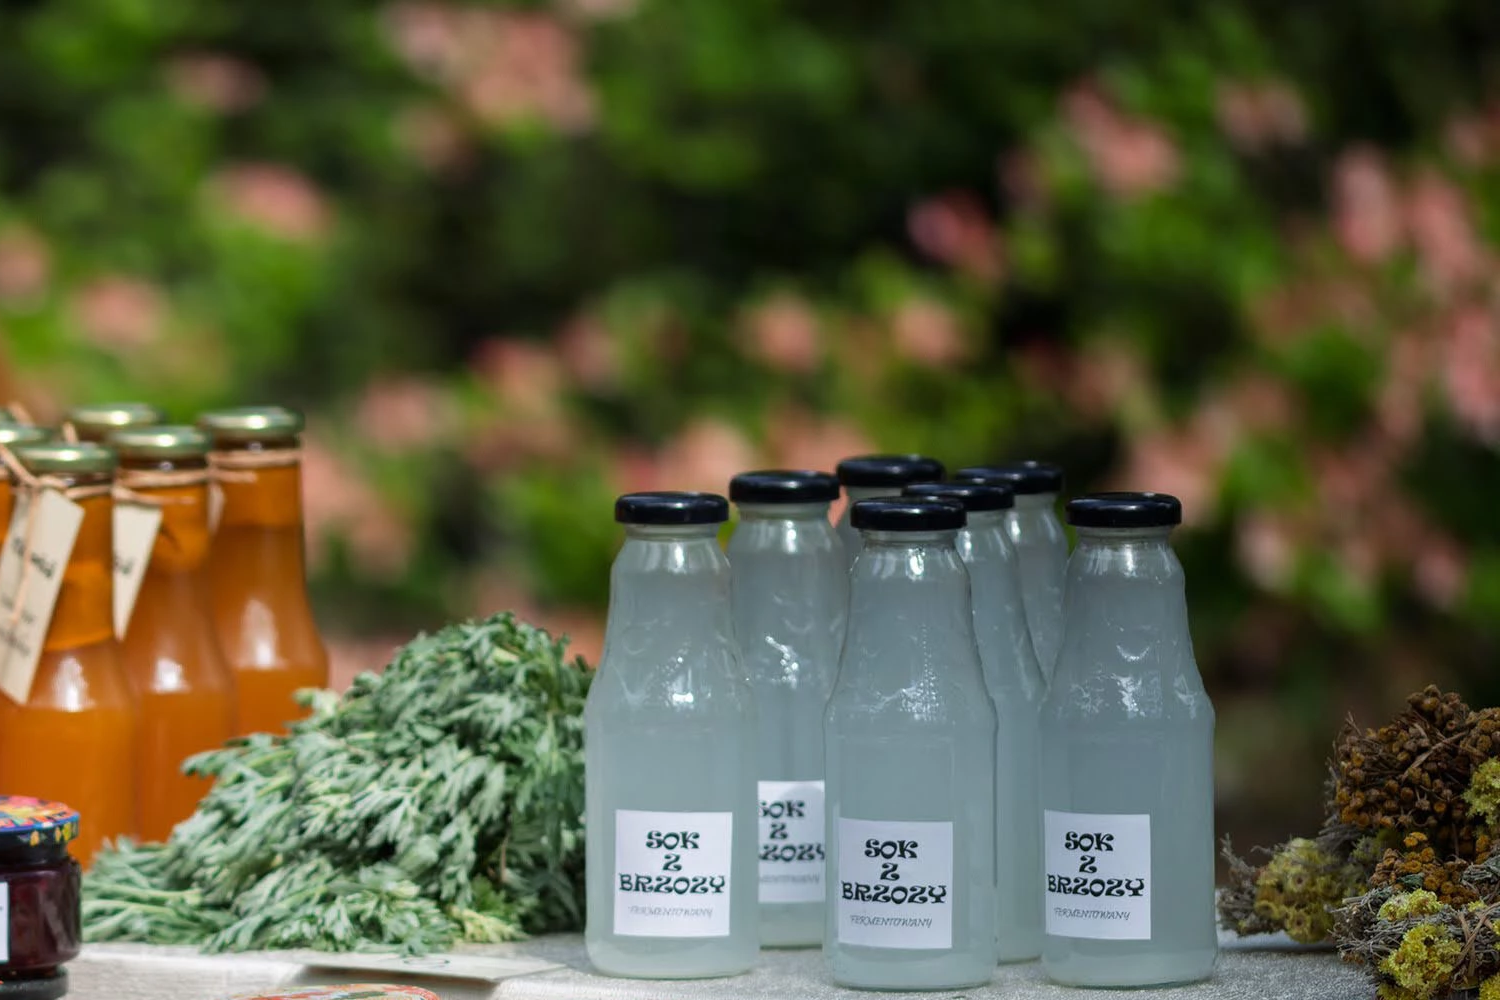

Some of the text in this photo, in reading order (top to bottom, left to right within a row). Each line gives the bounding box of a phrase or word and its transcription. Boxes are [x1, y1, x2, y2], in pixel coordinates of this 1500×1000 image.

[645, 830, 699, 850] SOK
[769, 821, 788, 839] Z
[864, 838, 918, 860] SOK
[1064, 830, 1114, 852] SOK
[662, 853, 682, 871] Z
[880, 862, 900, 881] Z
[1078, 854, 1097, 873] Z
[618, 871, 725, 895] BRZOZY
[840, 880, 946, 905] BRZOZY
[1046, 873, 1144, 898] BRZOZY
[850, 914, 932, 927] FERMENTOWANY
